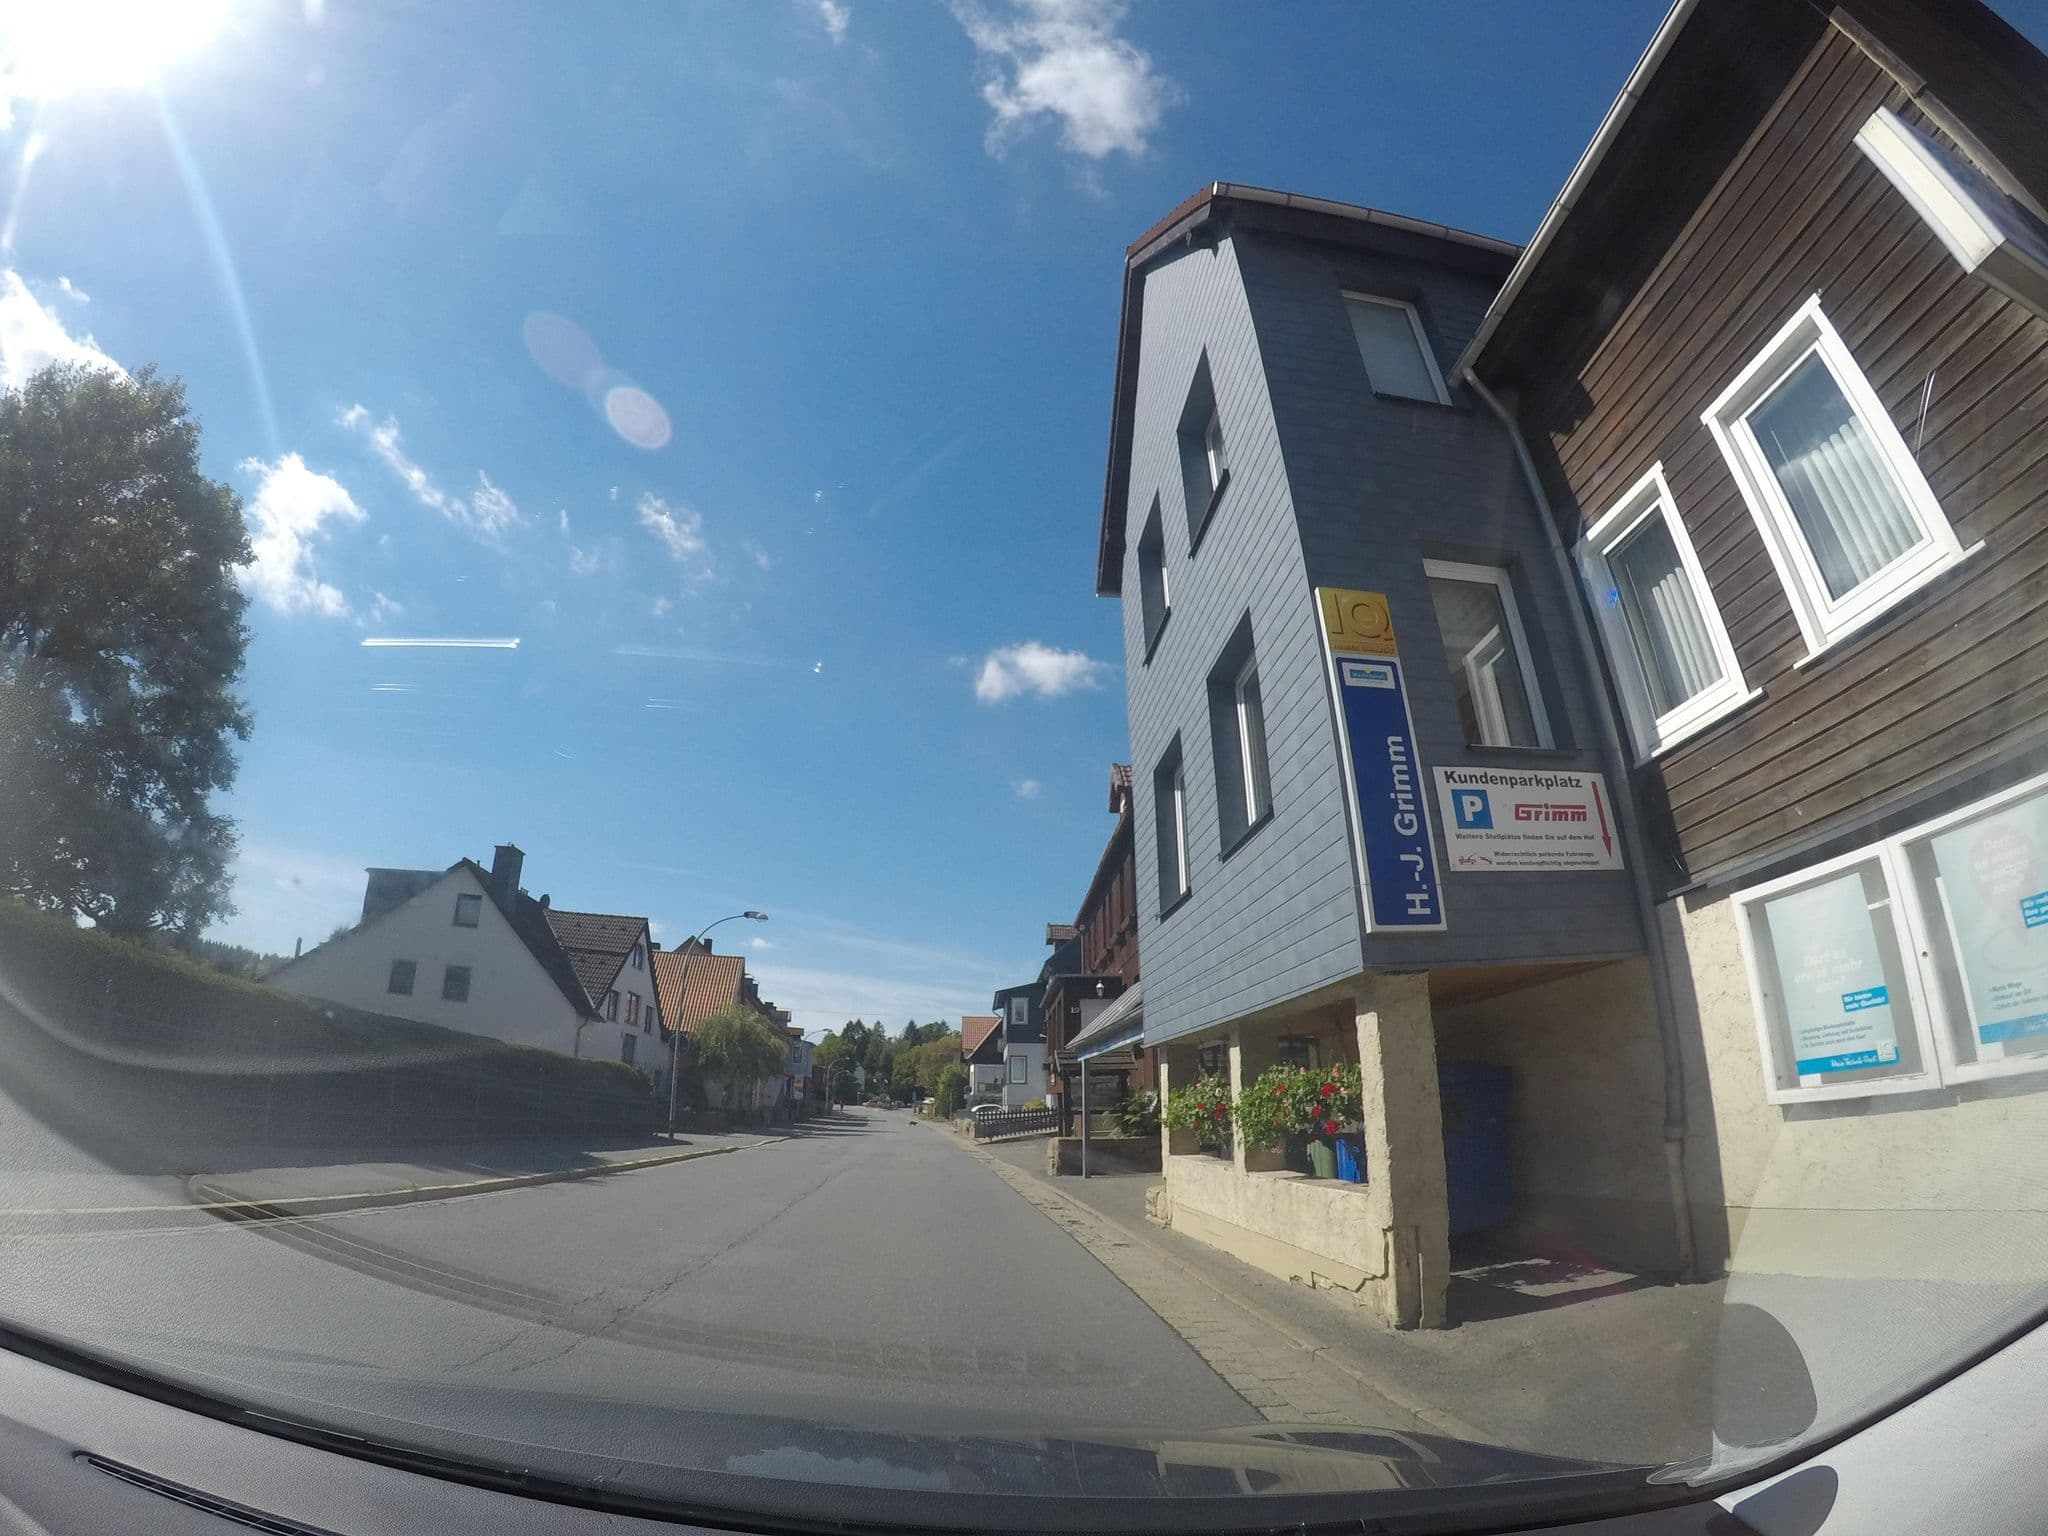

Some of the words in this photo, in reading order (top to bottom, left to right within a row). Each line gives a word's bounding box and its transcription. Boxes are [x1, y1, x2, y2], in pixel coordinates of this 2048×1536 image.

[1386, 735, 1418, 836] Grimm
[1444, 770, 1583, 790] Kundenparkplatz
[1461, 795, 1483, 822] P
[1514, 803, 1587, 822] Grimm
[1455, 832, 1483, 840] Weitere
[1399, 846, 1431, 916] H.-J.
